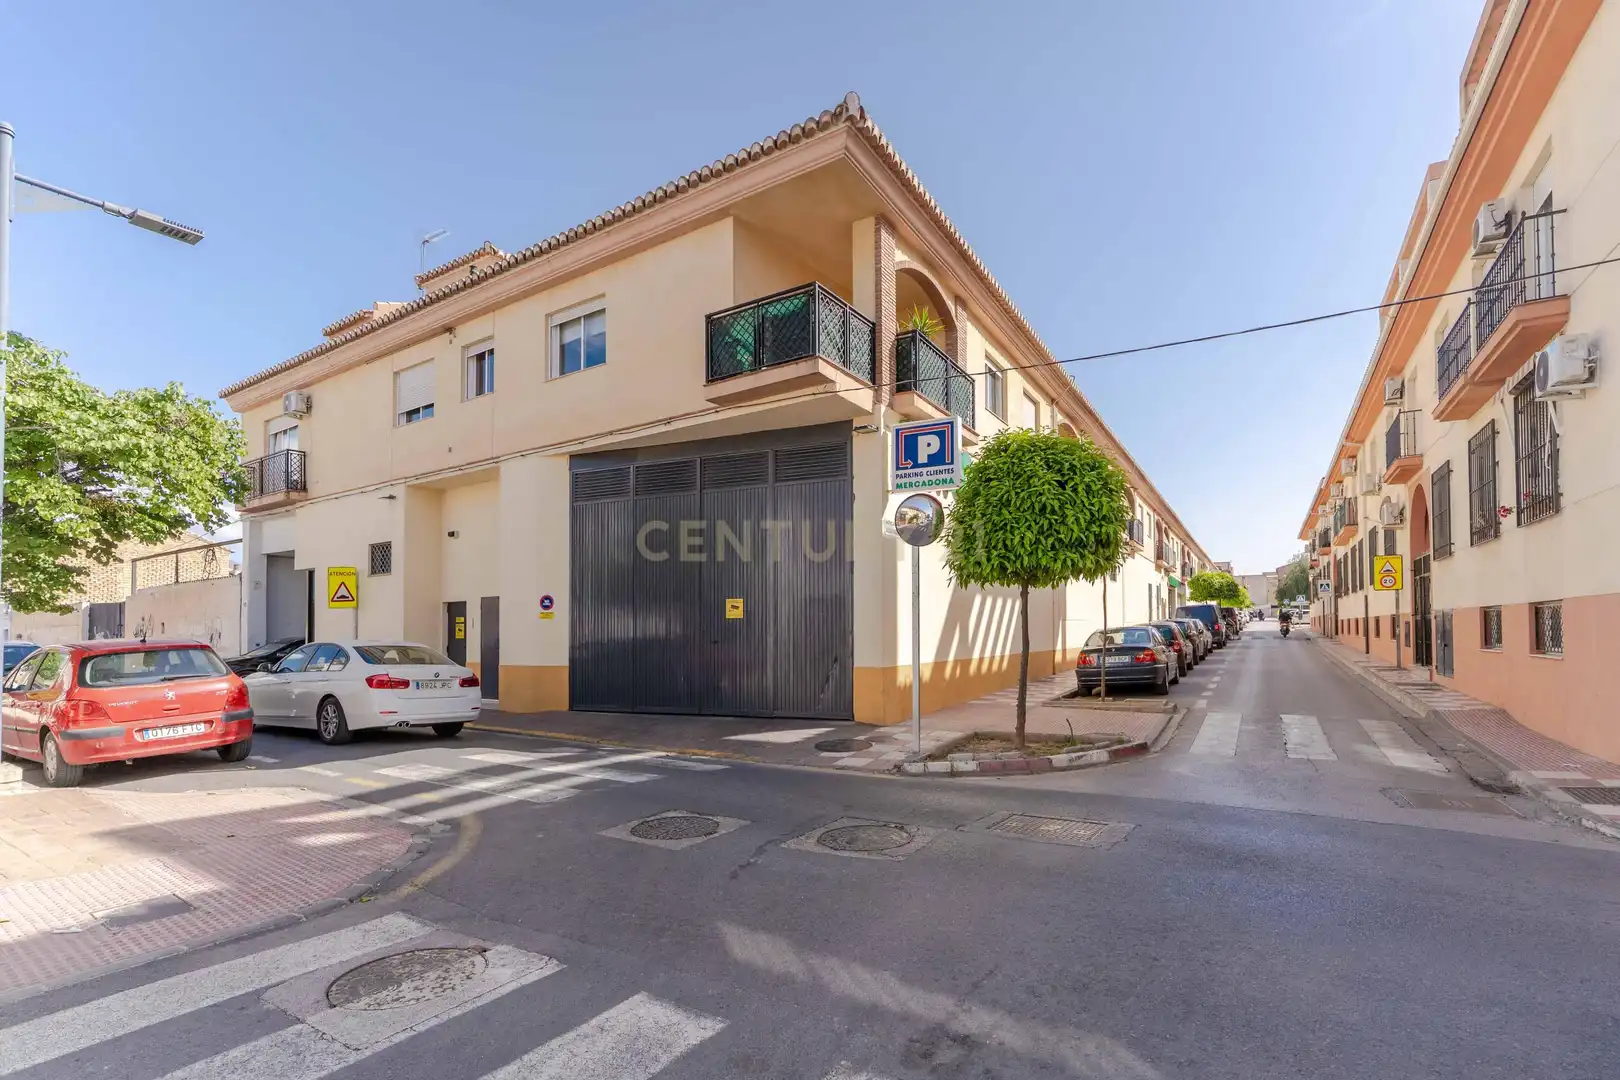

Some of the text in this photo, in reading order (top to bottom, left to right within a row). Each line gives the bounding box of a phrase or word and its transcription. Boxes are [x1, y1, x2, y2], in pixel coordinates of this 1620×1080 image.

[918, 434, 940, 464] P
[895, 468, 955, 480] PARKING CLIENTES
[896, 478, 955, 489] MERCADONA
